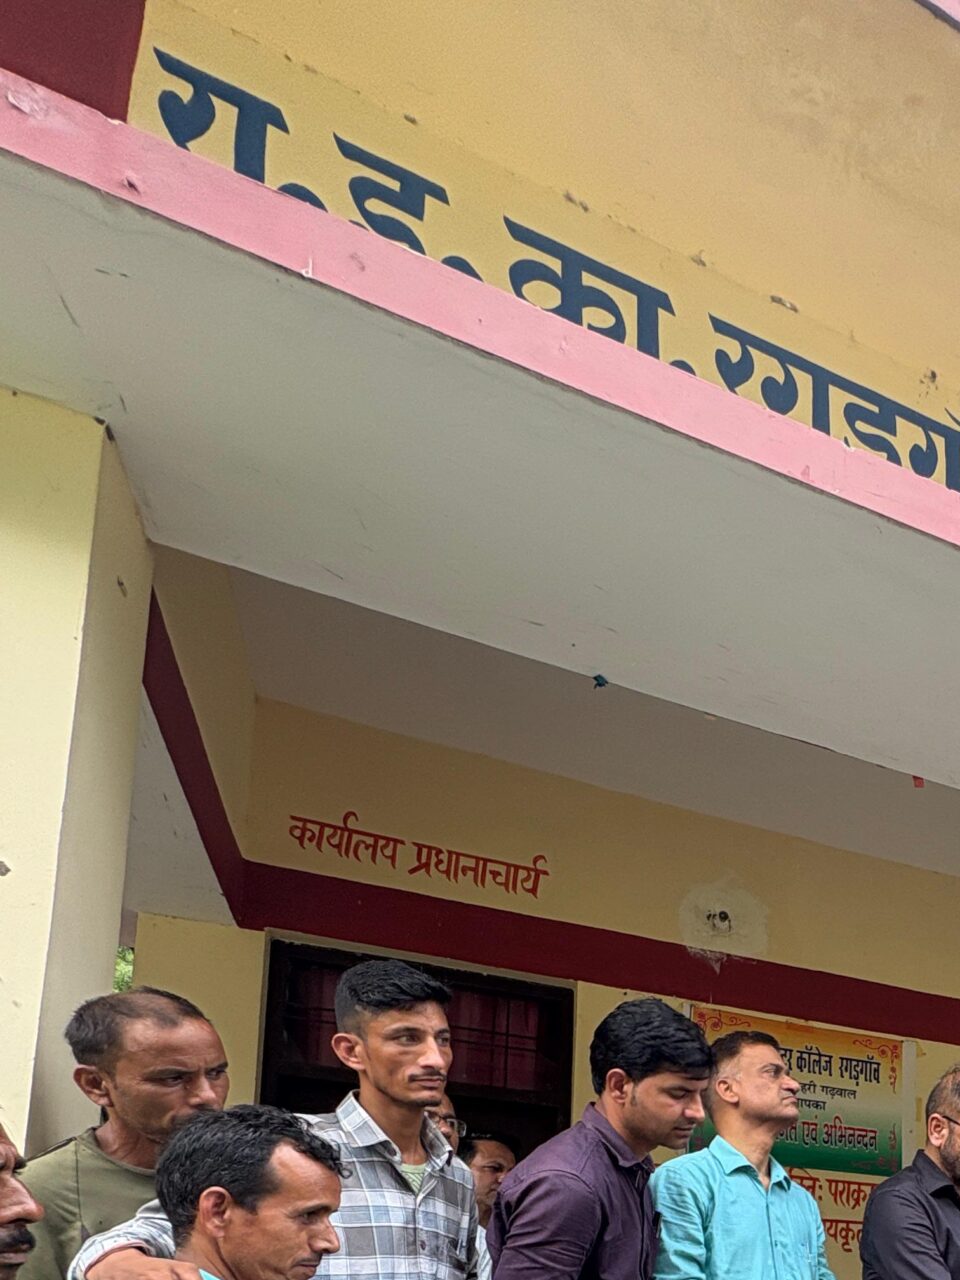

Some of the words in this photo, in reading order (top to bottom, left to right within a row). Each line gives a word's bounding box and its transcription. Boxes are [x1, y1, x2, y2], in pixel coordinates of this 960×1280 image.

[289, 811, 405, 869] कार्यालय
[408, 841, 549, 899] प्रधानाचार्य
[796, 1044, 833, 1076] कॉलेज
[820, 1084, 857, 1099] गढ़वाल
[825, 1178, 879, 1210] पराक्र
